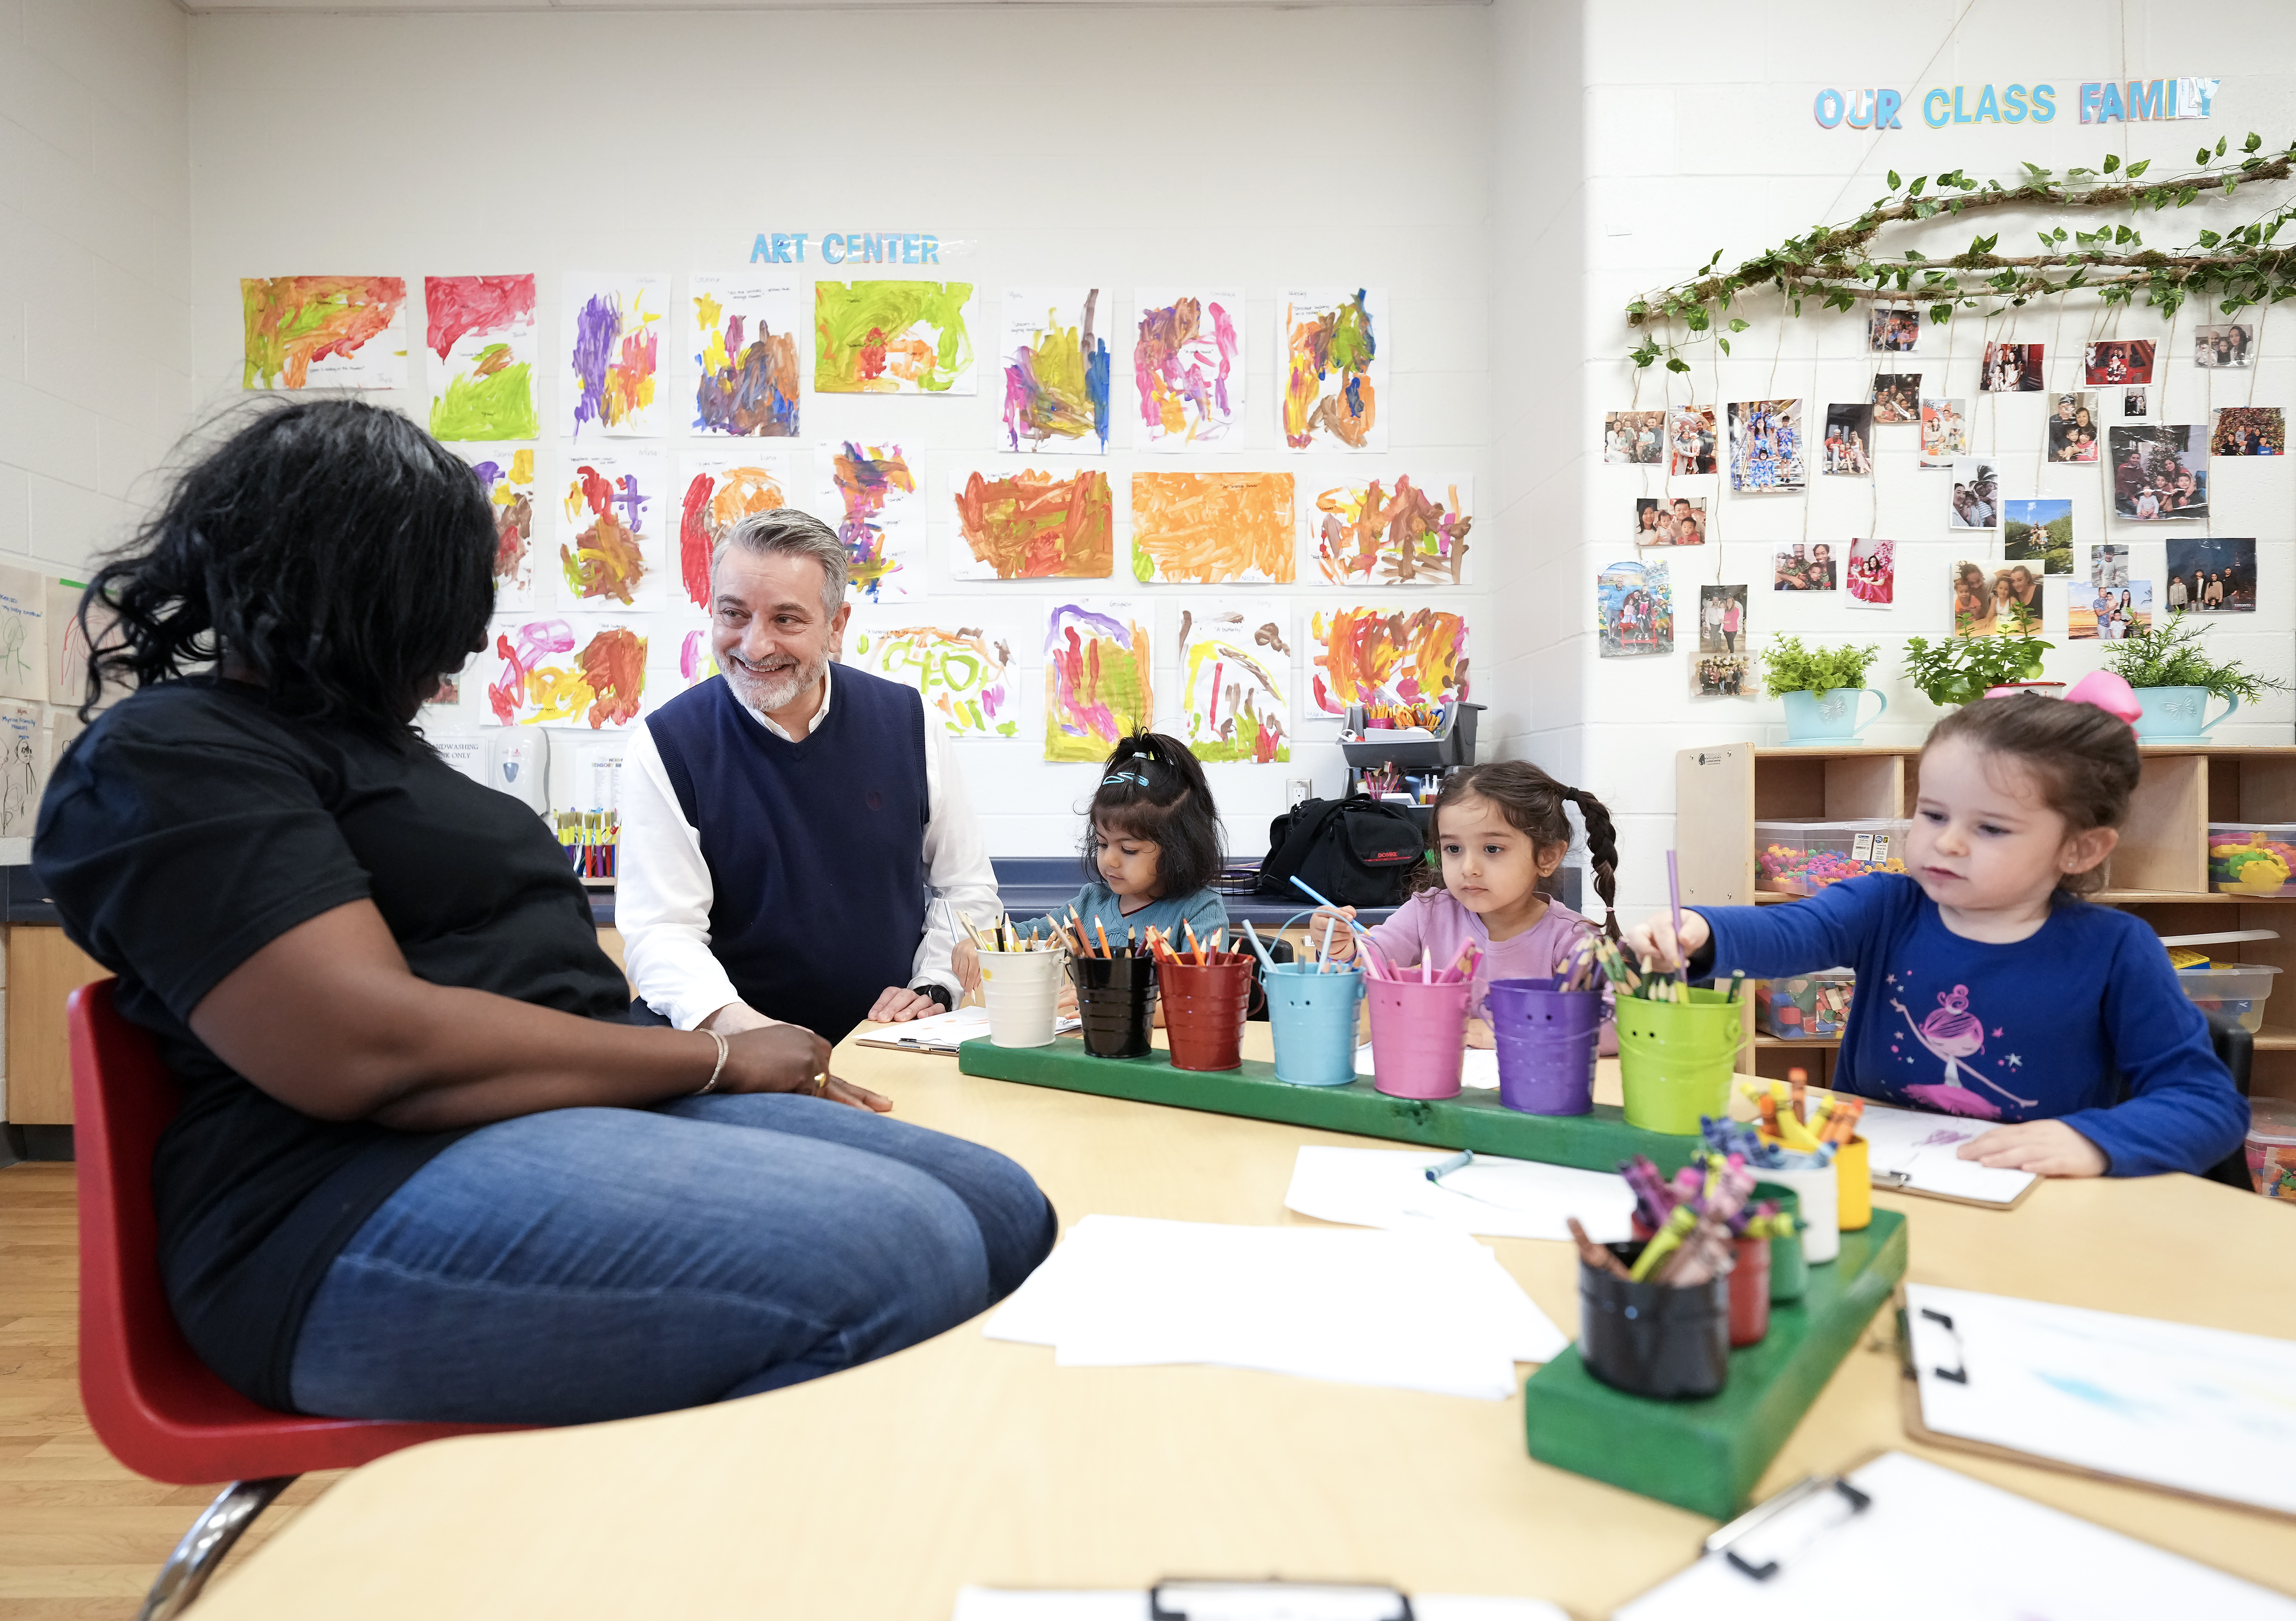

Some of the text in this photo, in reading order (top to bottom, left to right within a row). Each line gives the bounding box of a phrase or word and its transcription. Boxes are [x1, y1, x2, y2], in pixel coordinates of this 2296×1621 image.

[1814, 77, 2221, 129] OUR CLASS FAMILY
[750, 232, 940, 265] ART CENTER
[1109, 601, 1132, 609] Grayson
